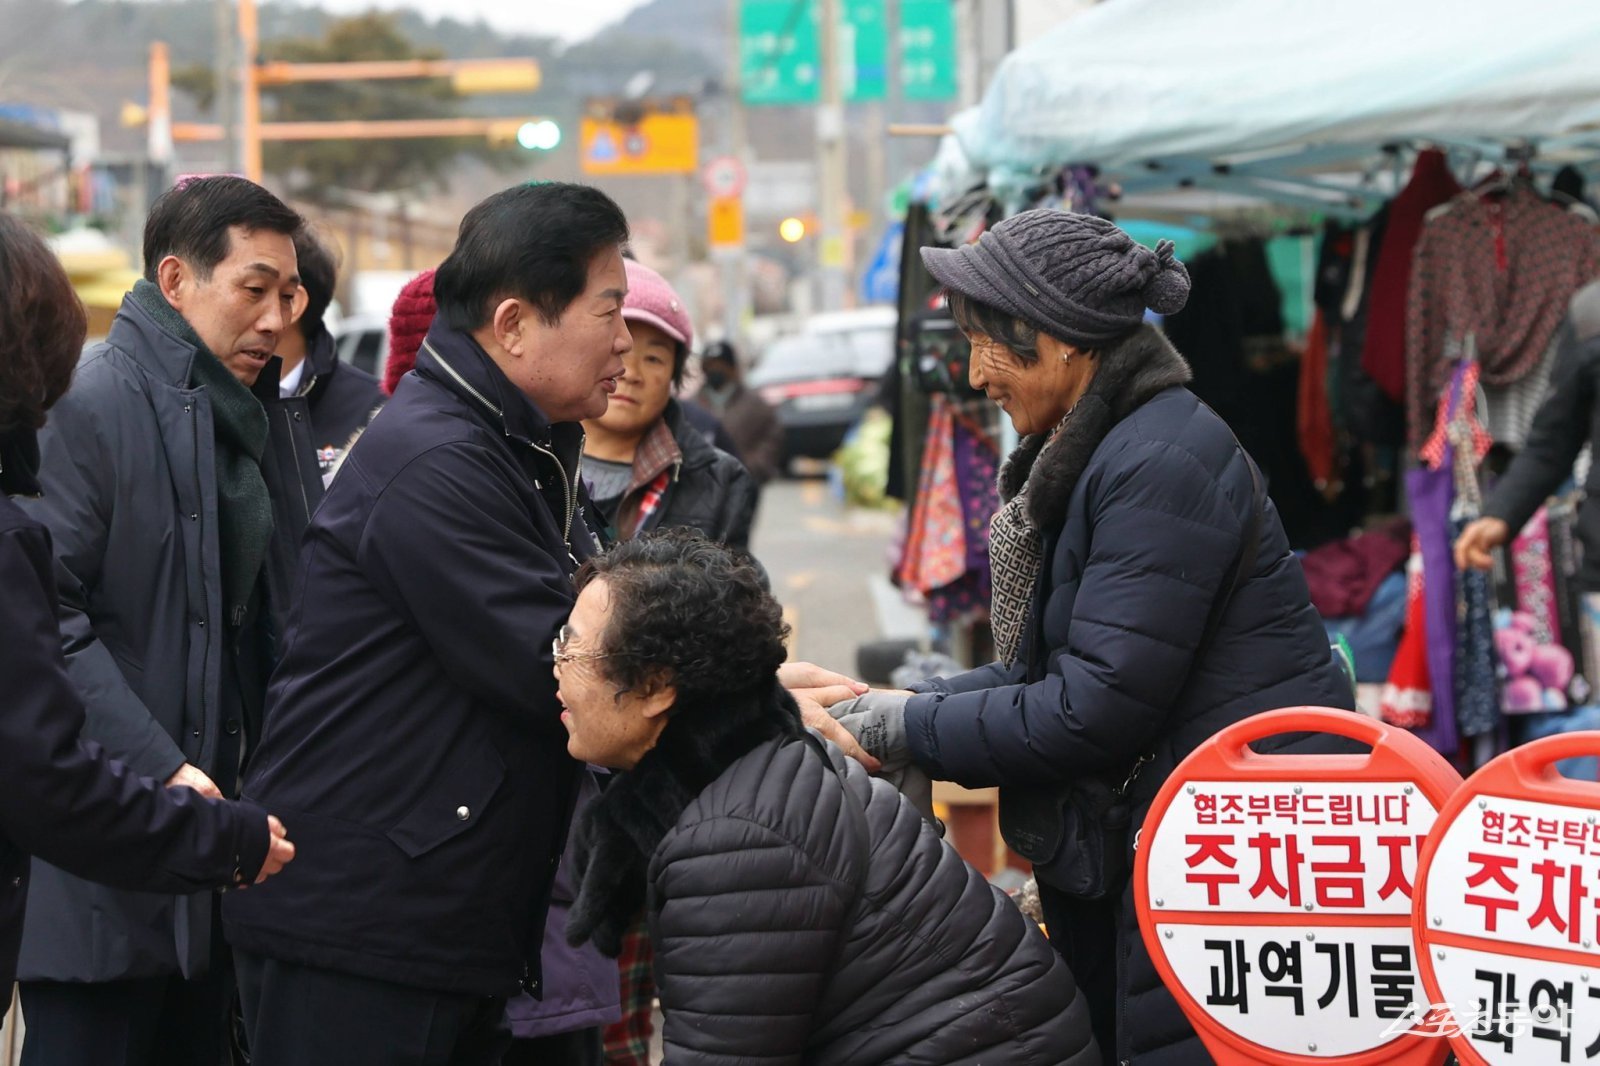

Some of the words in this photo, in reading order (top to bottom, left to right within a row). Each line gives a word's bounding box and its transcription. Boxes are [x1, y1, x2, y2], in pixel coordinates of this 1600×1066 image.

[1193, 793, 1410, 826] 협조부탁드립니다
[1464, 851, 1600, 947] 주차
[1203, 939, 1415, 1019] 과역기물
